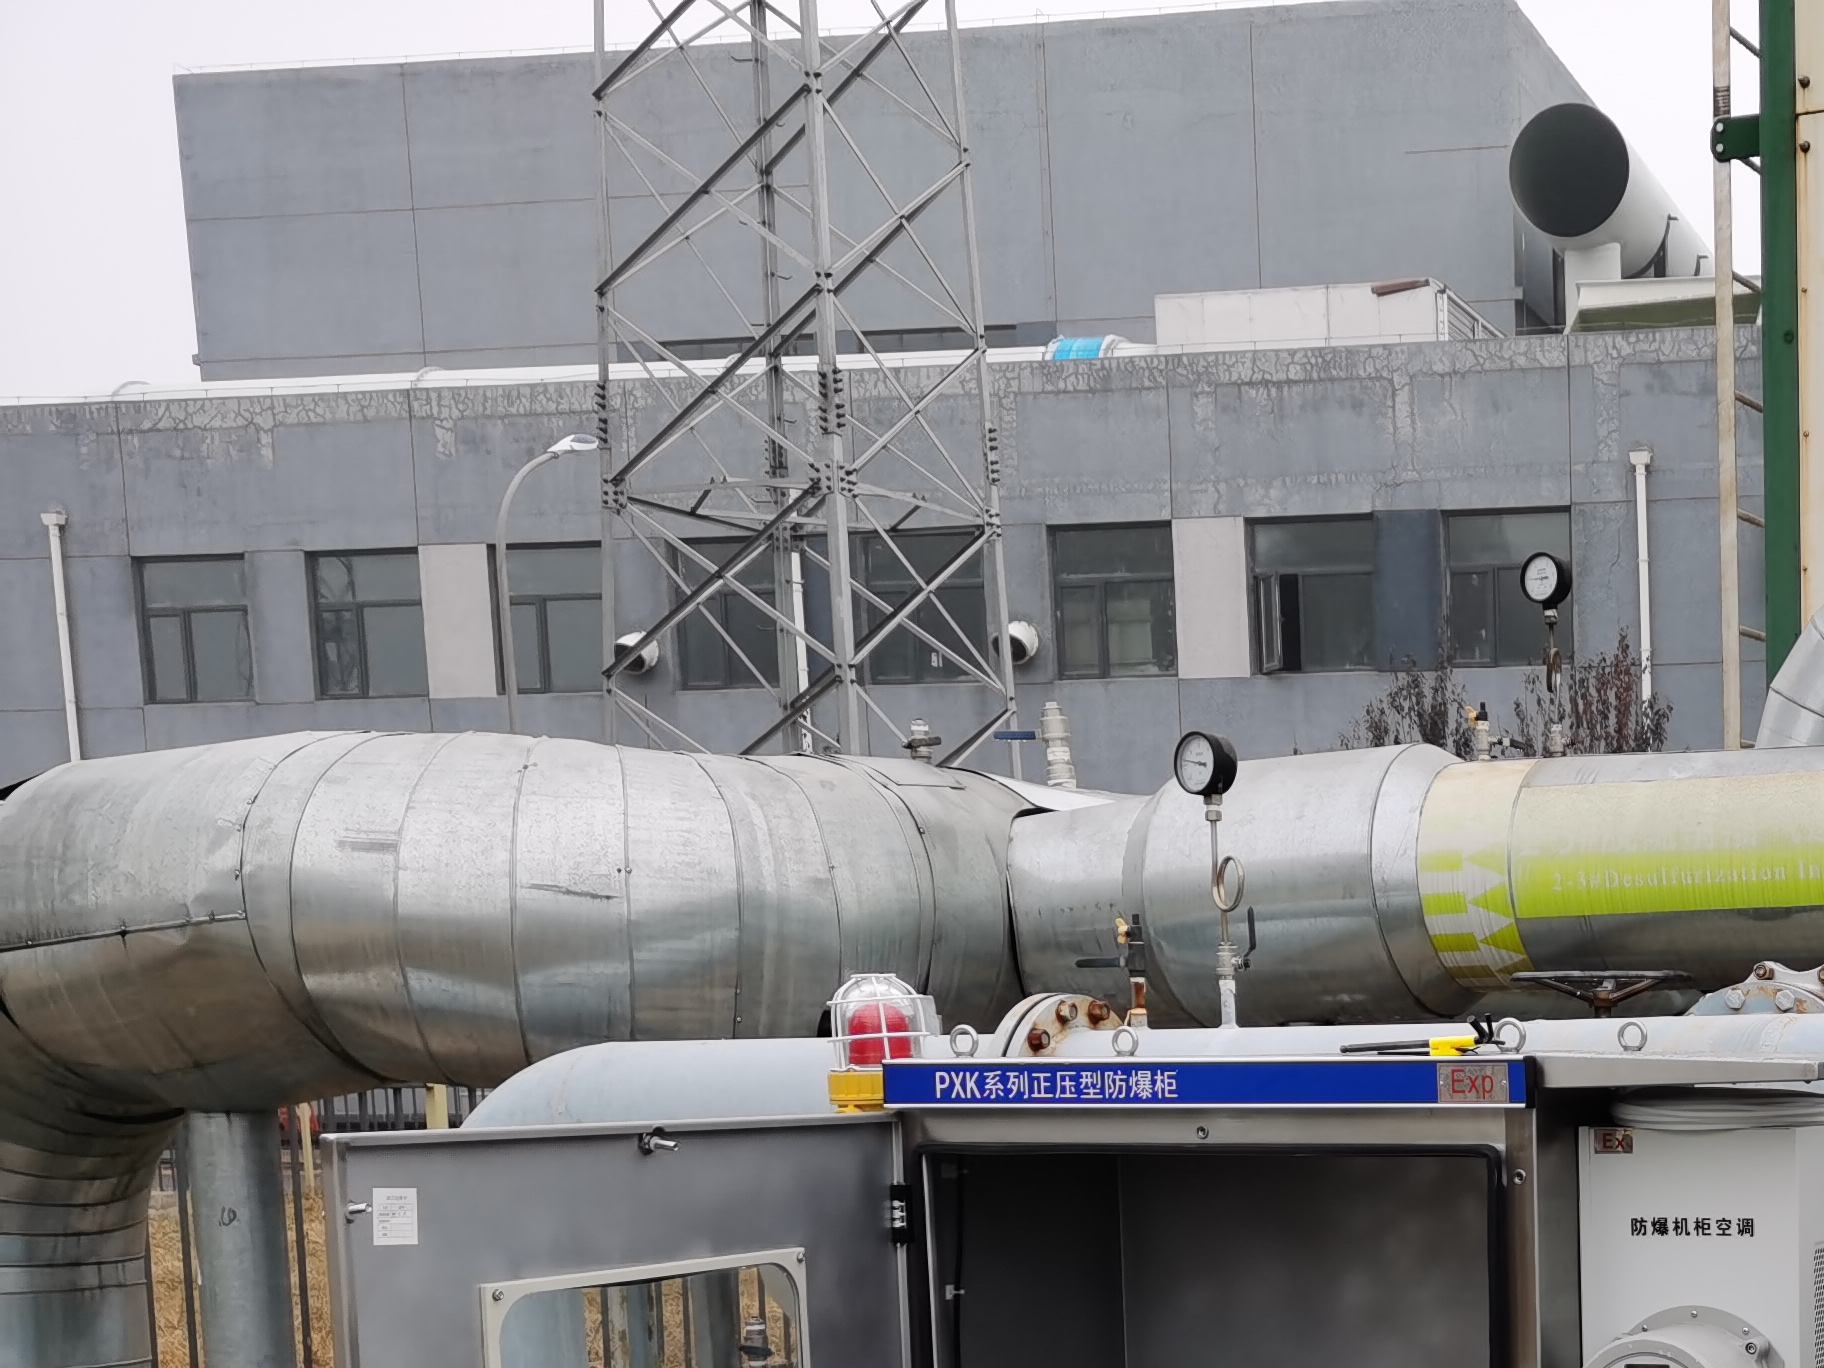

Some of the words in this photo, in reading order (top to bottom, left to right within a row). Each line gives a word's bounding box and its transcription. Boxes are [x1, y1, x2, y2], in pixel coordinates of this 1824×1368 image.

[935, 1070, 1179, 1101] PXK系列正压型防爆柜
[1450, 1068, 1495, 1097] Exp
[1602, 1132, 1625, 1150] Ex
[1630, 1216, 1755, 1237] 防爆机柜空调
